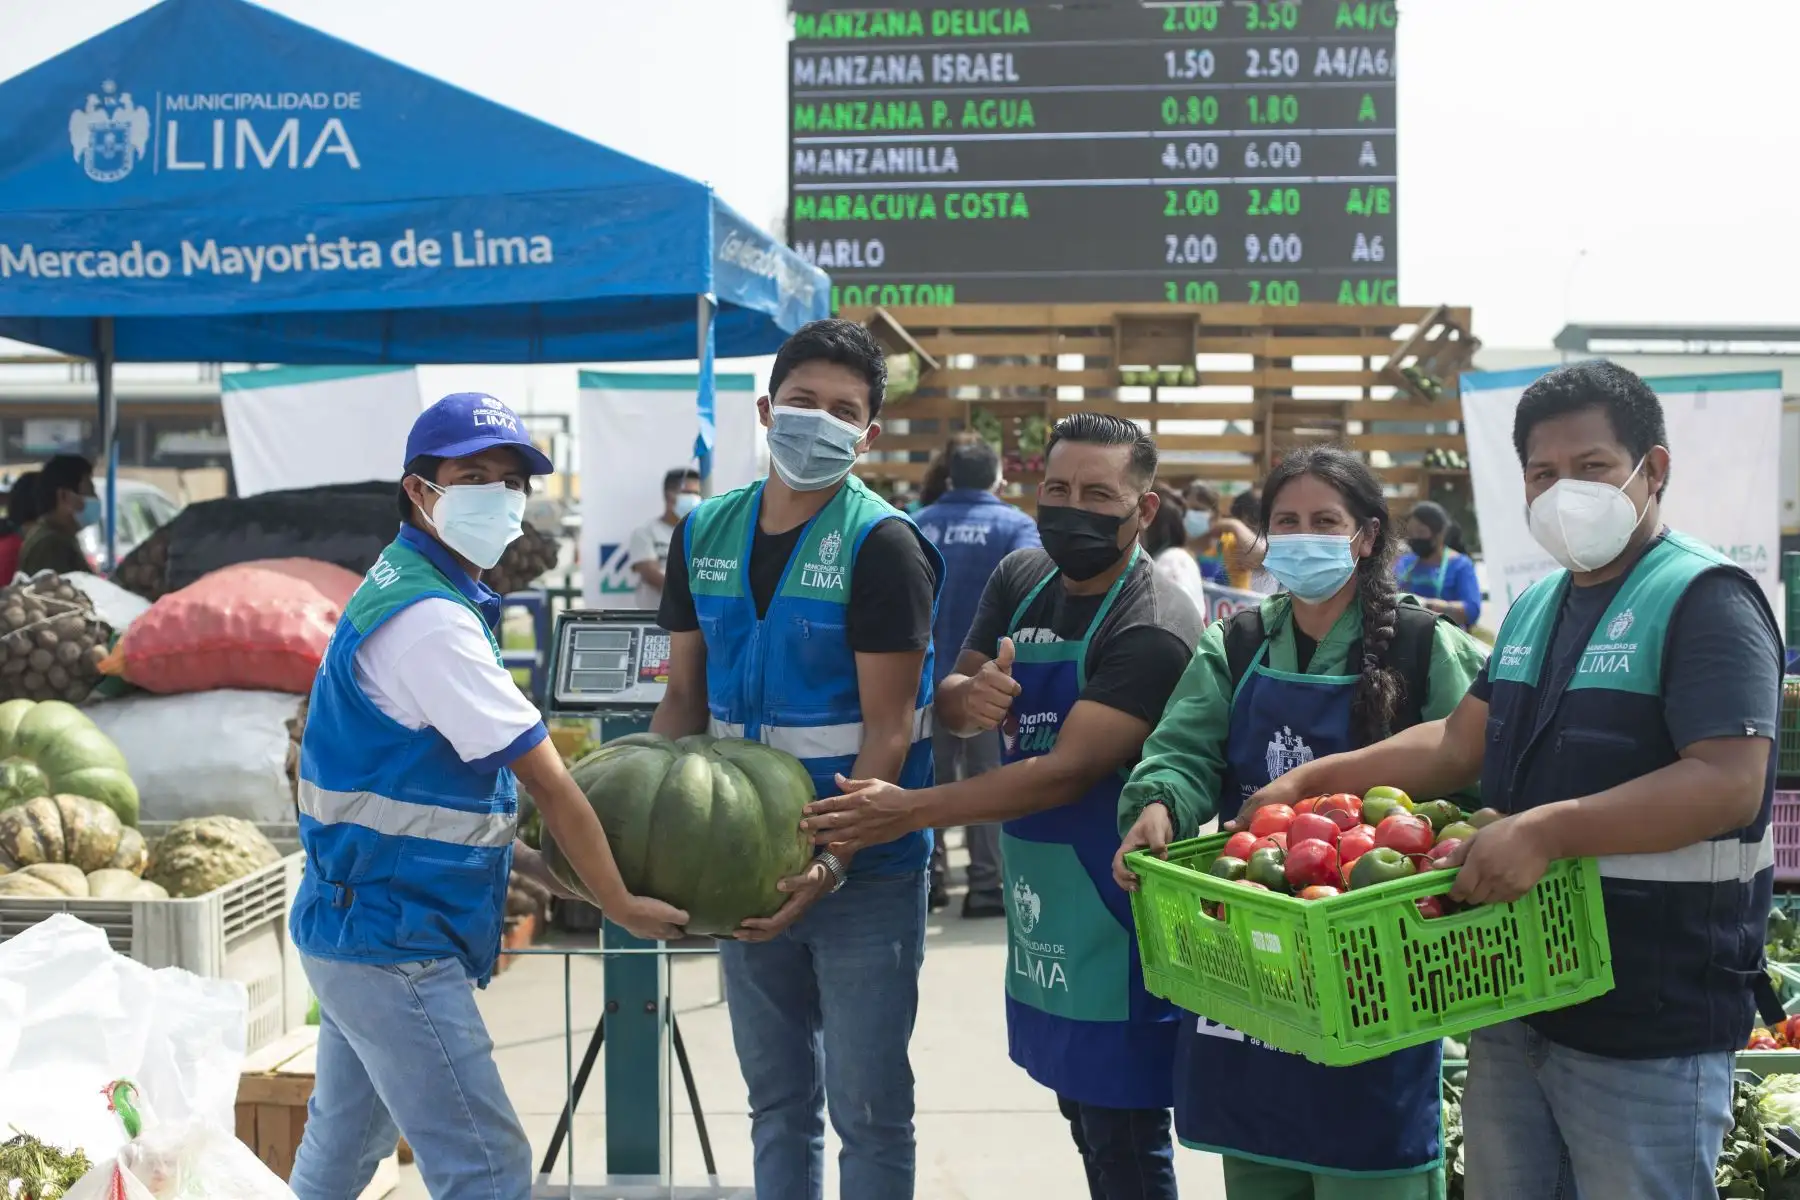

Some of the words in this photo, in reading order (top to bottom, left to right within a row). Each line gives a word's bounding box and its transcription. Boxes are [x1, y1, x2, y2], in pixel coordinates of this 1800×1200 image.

[795, 9, 924, 38] MANZANA
[932, 8, 1031, 37] DELICIA
[1163, 4, 1218, 31] 2.00
[1245, 3, 1298, 30] 3.50
[794, 54, 924, 85] MANZANA
[932, 53, 1019, 83] ISRAEL
[1165, 50, 1215, 78] 1.50
[1246, 48, 1299, 78] 2.50
[166, 92, 329, 111] MUNICIPALIDAD
[333, 92, 361, 109] DE
[794, 101, 924, 130] MANZANA
[932, 100, 952, 128] P.
[962, 99, 1035, 129] AGUA
[1247, 94, 1298, 124] 1.80
[1358, 93, 1376, 122] A
[166, 117, 361, 170] LIMA
[794, 146, 959, 175] MANZANILLA
[1161, 142, 1219, 169] 4.00
[1244, 141, 1301, 168] 6.00
[1358, 141, 1377, 167] A
[794, 193, 937, 221] MARACUYA
[944, 192, 1029, 219] COSTA
[1163, 189, 1219, 216] 2.00
[1247, 188, 1300, 216] 2.40
[0, 240, 171, 278] Mercado
[181, 233, 382, 283] Mayorista
[390, 228, 442, 267] de
[452, 229, 553, 267] Lima
[795, 239, 885, 268] MARLO
[1165, 234, 1218, 263] 7.00
[1245, 233, 1302, 263] 9.00
[1352, 233, 1385, 262] A6
[473, 414, 519, 435] LIMA
[801, 570, 844, 590] LIMA
[1579, 654, 1630, 673] LIMA
[1053, 944, 1066, 955] DE
